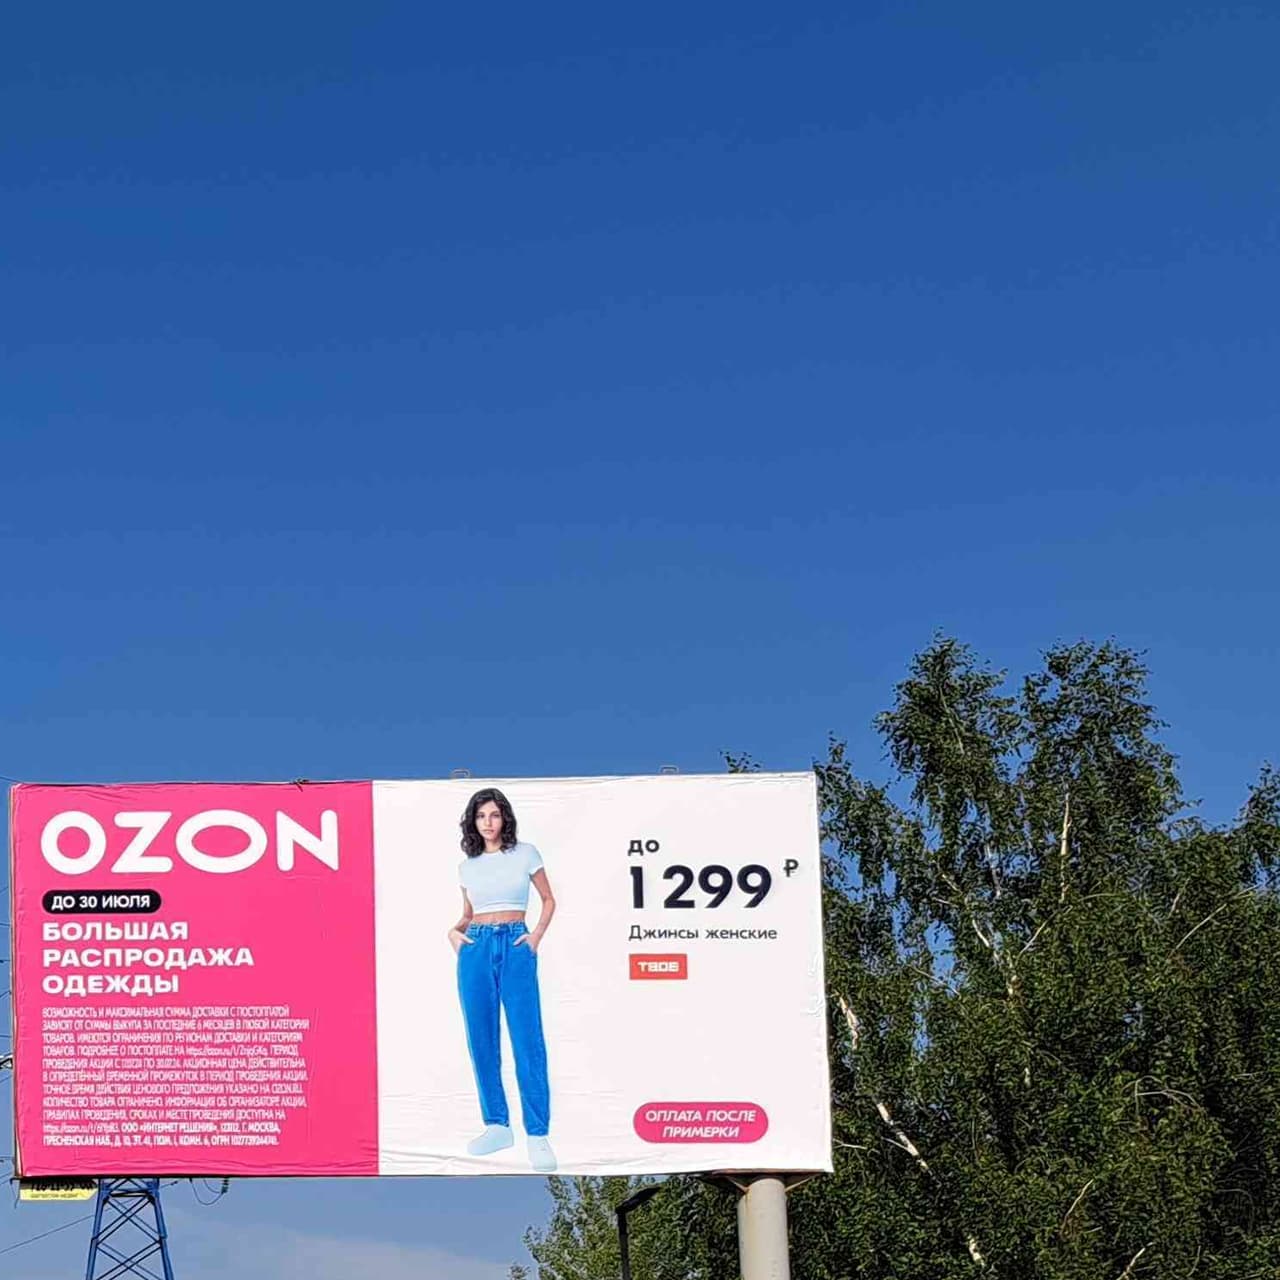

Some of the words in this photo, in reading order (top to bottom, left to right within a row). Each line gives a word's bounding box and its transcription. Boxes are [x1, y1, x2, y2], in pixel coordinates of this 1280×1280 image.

[40, 809, 339, 875] OZON
[51, 895, 76, 911] ДО
[79, 895, 98, 909] 30
[102, 894, 151, 909] ИЮЛЯ
[42, 921, 188, 941] БОЛЬШАЯ
[628, 924, 699, 941] Джинсы
[705, 928, 778, 940] женские
[42, 947, 254, 970] РАСПРОДАЖА
[42, 974, 180, 997] ОДЕЖДЫ
[645, 1110, 702, 1122] ОПЛАТА
[705, 1110, 757, 1122] ПОСЛЕ
[662, 1126, 740, 1138] ПРИМЕРКИ
